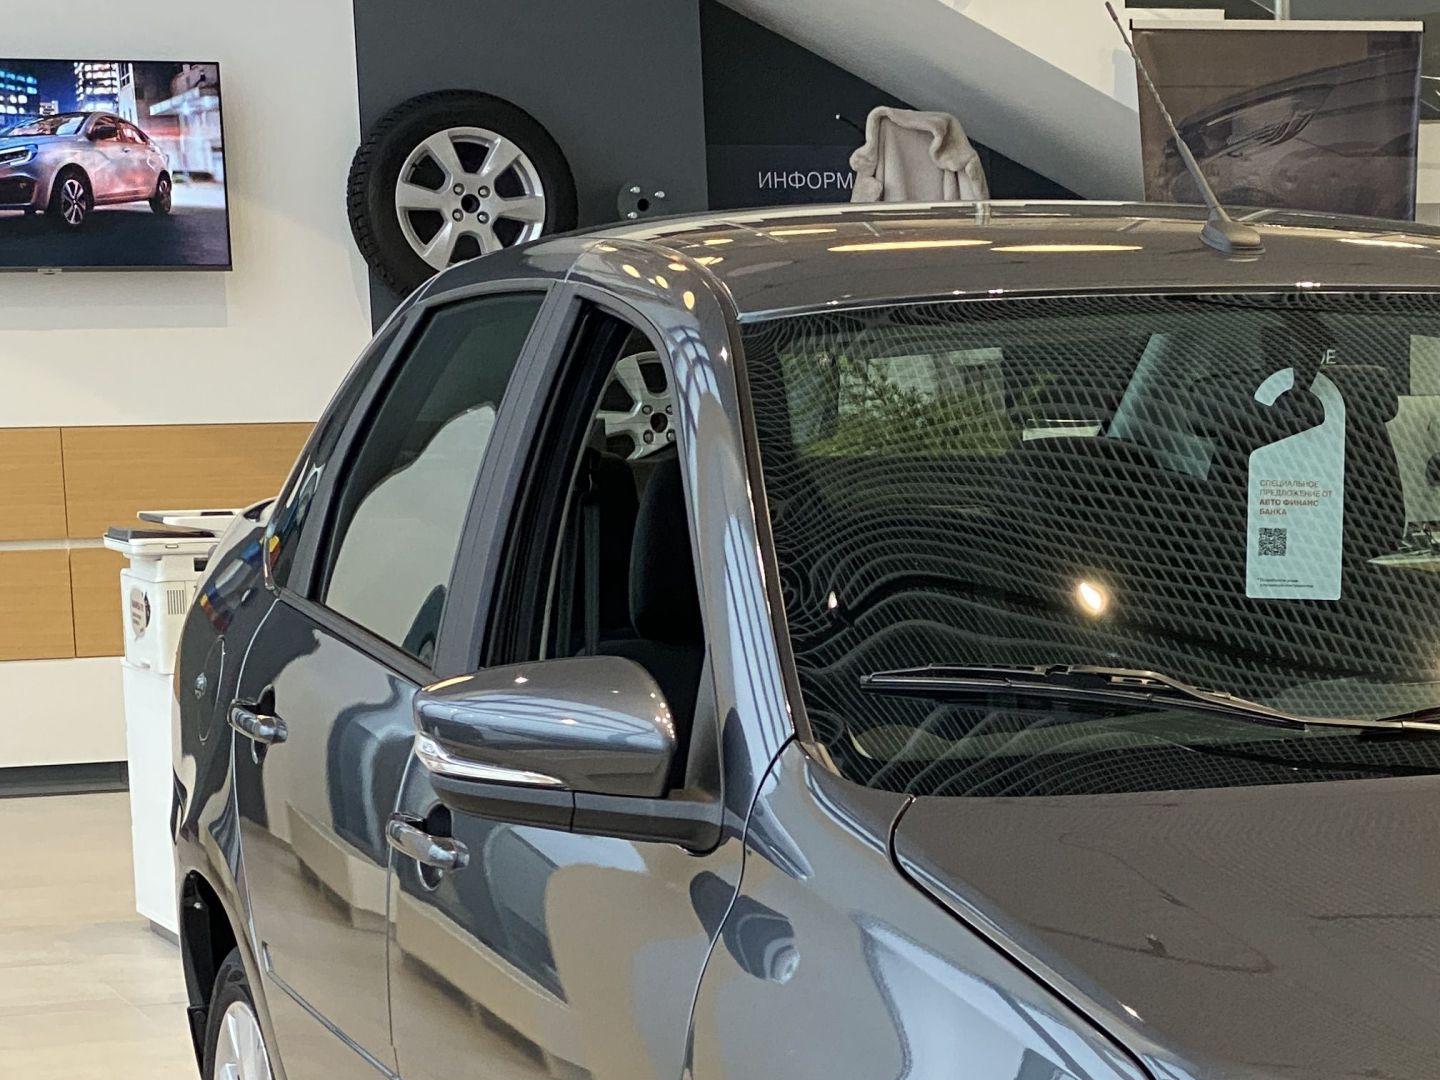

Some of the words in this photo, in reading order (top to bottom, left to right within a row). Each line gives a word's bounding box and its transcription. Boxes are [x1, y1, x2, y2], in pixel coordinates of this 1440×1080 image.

[1260, 480, 1319, 488] СПЕЦИАЛЬНОЕ
[1259, 488, 1320, 498] ПРЕДЛОЖЕНИЕ
[1322, 490, 1333, 498] ОТ
[1283, 499, 1319, 507] ФИНАНС
[1259, 508, 1287, 516] БАНКА
